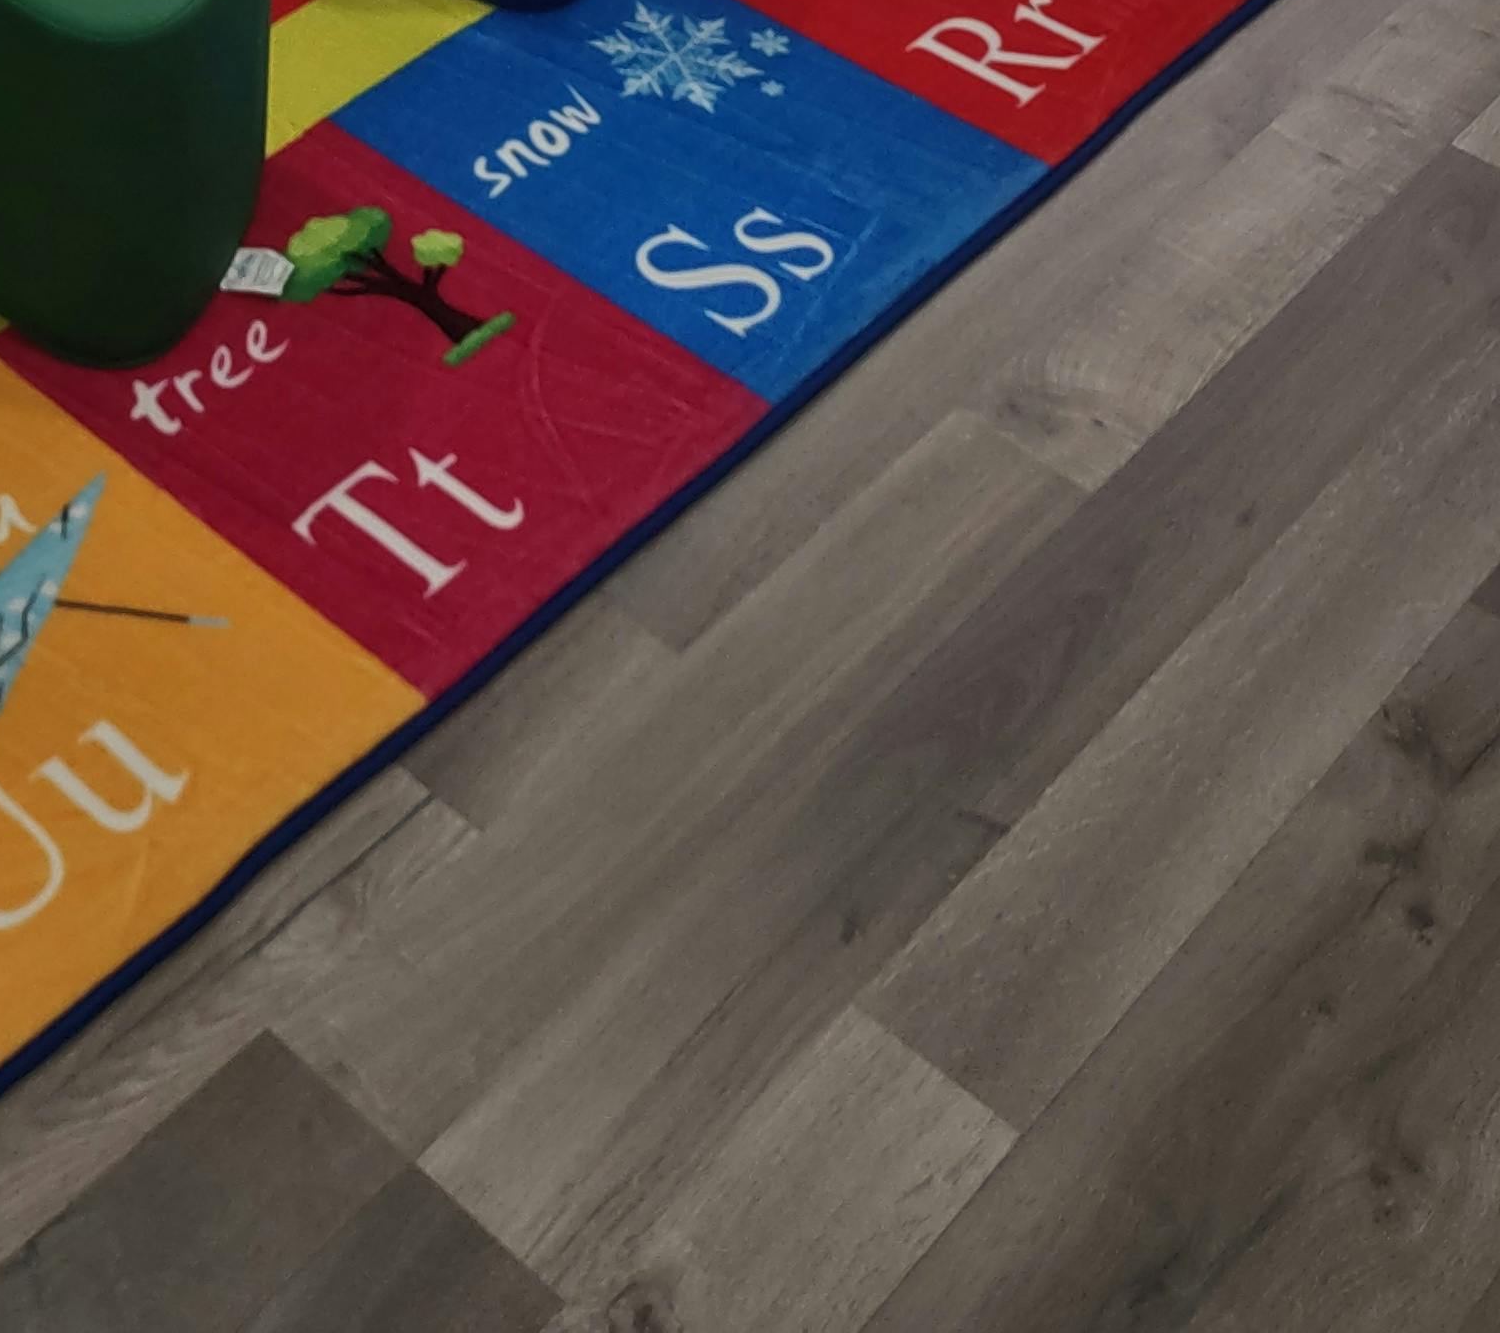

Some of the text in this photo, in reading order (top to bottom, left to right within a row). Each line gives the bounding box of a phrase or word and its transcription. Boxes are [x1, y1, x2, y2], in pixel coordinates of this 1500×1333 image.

[473, 85, 602, 198] snow
[636, 208, 833, 335] Ss
[131, 320, 286, 434] tree
[293, 450, 523, 594] Tt
